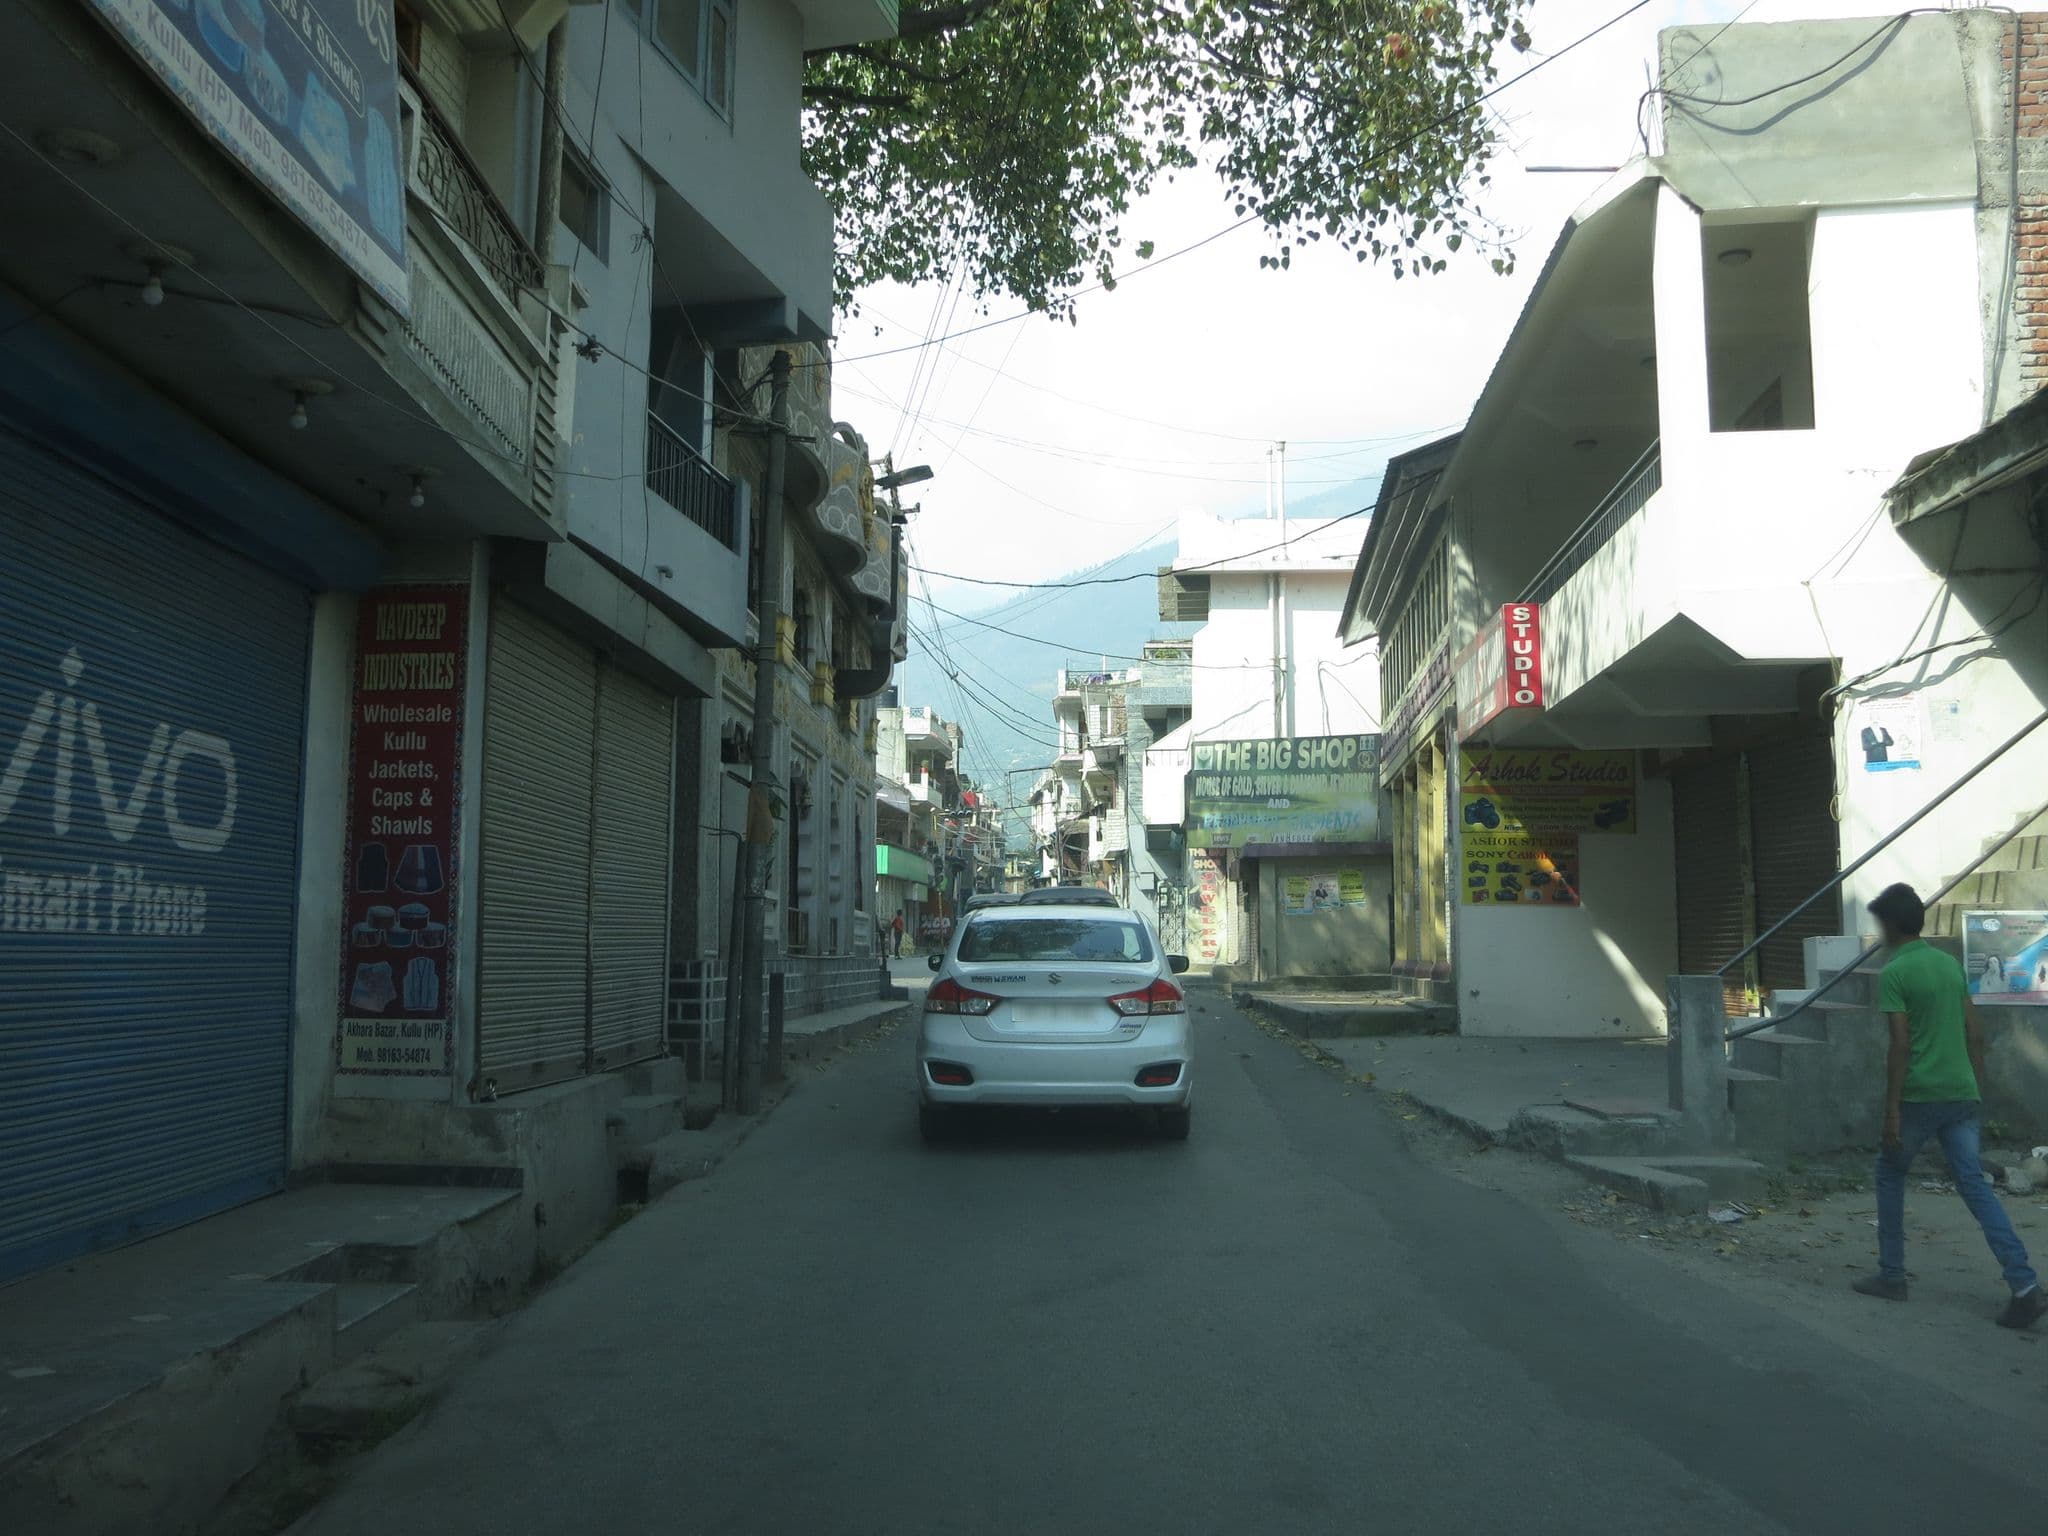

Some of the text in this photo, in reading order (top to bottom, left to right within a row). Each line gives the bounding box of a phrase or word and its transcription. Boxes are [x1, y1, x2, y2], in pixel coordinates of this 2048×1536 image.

[302, 5, 360, 103] & Shawls
[148, 2, 368, 257] Kullu (HP) Mob. 98163-54874
[376, 602, 447, 641] NAVDEEP
[1513, 606, 1535, 704] STUDIO
[362, 652, 455, 690] INDUSTRIES
[363, 703, 452, 723] Wholesale
[384, 731, 427, 750] Kullu
[1214, 738, 1357, 772] THE BIG SHOP
[368, 759, 439, 782] Jackets,
[1465, 752, 1629, 782] Ashok Studio
[1195, 775, 1221, 797] HOUSE
[1221, 775, 1232, 797] OF
[372, 788, 433, 811] Caps &
[1267, 798, 1290, 809] AND
[371, 815, 433, 836] Shawls
[1470, 837, 1518, 847] ASHOK
[1193, 859, 1218, 869] SHO
[1466, 850, 1505, 858] SONY
[0, 862, 207, 935] mart Phone
[347, 1022, 373, 1037] Akhara
[401, 1022, 422, 1037] Kullu
[424, 1022, 443, 1040] (HP)
